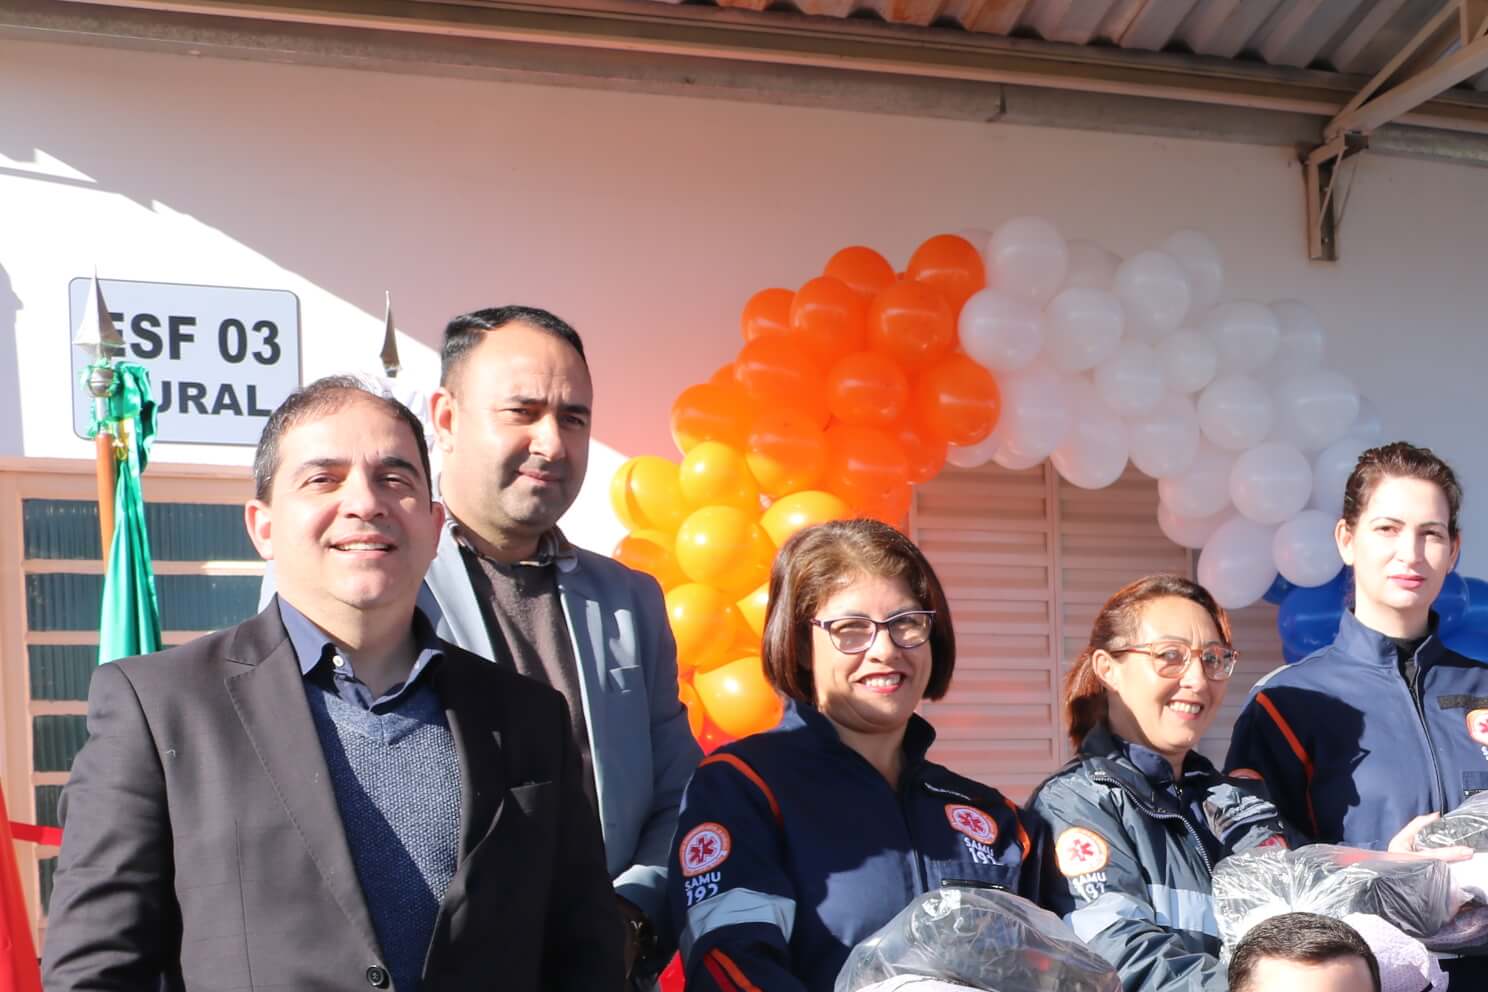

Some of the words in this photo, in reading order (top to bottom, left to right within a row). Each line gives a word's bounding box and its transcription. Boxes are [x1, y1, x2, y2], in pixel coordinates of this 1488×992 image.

[218, 318, 281, 366] 03
[158, 380, 272, 417] RAL
[684, 870, 721, 892] SAMU
[685, 883, 719, 907] 192
